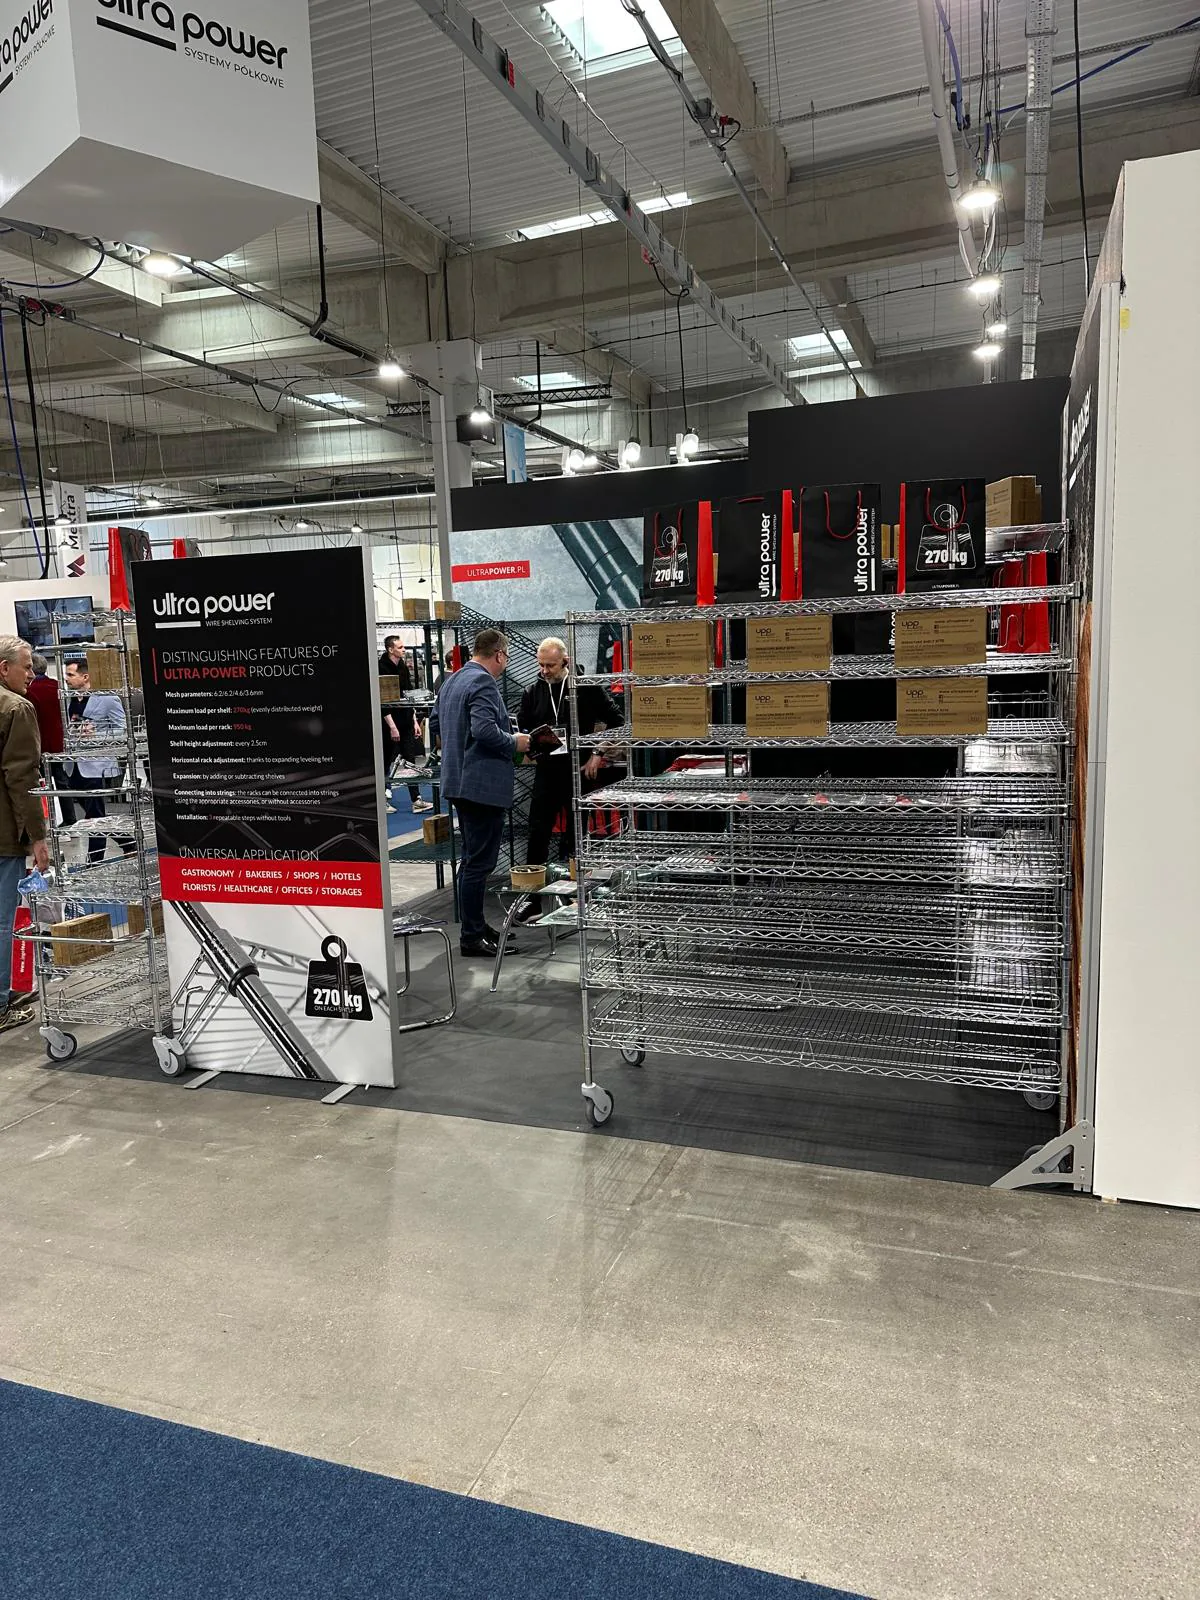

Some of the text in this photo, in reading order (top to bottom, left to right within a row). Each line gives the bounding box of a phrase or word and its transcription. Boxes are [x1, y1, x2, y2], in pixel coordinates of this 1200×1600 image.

[182, 12, 288, 69] power
[184, 46, 285, 88] SYSTEMY PÓŁKOWE
[758, 513, 772, 598] ultra power
[854, 506, 870, 592] ultra power
[925, 549, 968, 566] 270 kg
[467, 566, 526, 577] ULTRAPOWER.PL
[655, 568, 684, 583] 270 kg
[153, 592, 275, 619] ultra power
[222, 618, 249, 626] SHELVING
[162, 645, 338, 664] DISTINGUISHING FEATURES OF
[164, 664, 314, 680] ULTRA POWER PRODUCTS
[906, 690, 924, 698] upp
[251, 706, 270, 714] (evenly
[271, 705, 301, 713] distributed
[302, 704, 322, 713] weight)
[320, 789, 339, 797] strings
[178, 847, 319, 862] UNIVERSAL APPLICATION
[181, 868, 234, 878] GASTRONOMY
[245, 870, 282, 879] BAKERIES
[293, 872, 320, 880] SHOPS
[331, 872, 361, 881] HOTELS
[182, 883, 216, 892] FLORISTS
[224, 884, 273, 894] HEALTHCARE
[281, 886, 313, 895] OFFICES
[321, 887, 362, 896] STORAGES
[313, 988, 363, 1012] 270 kg
